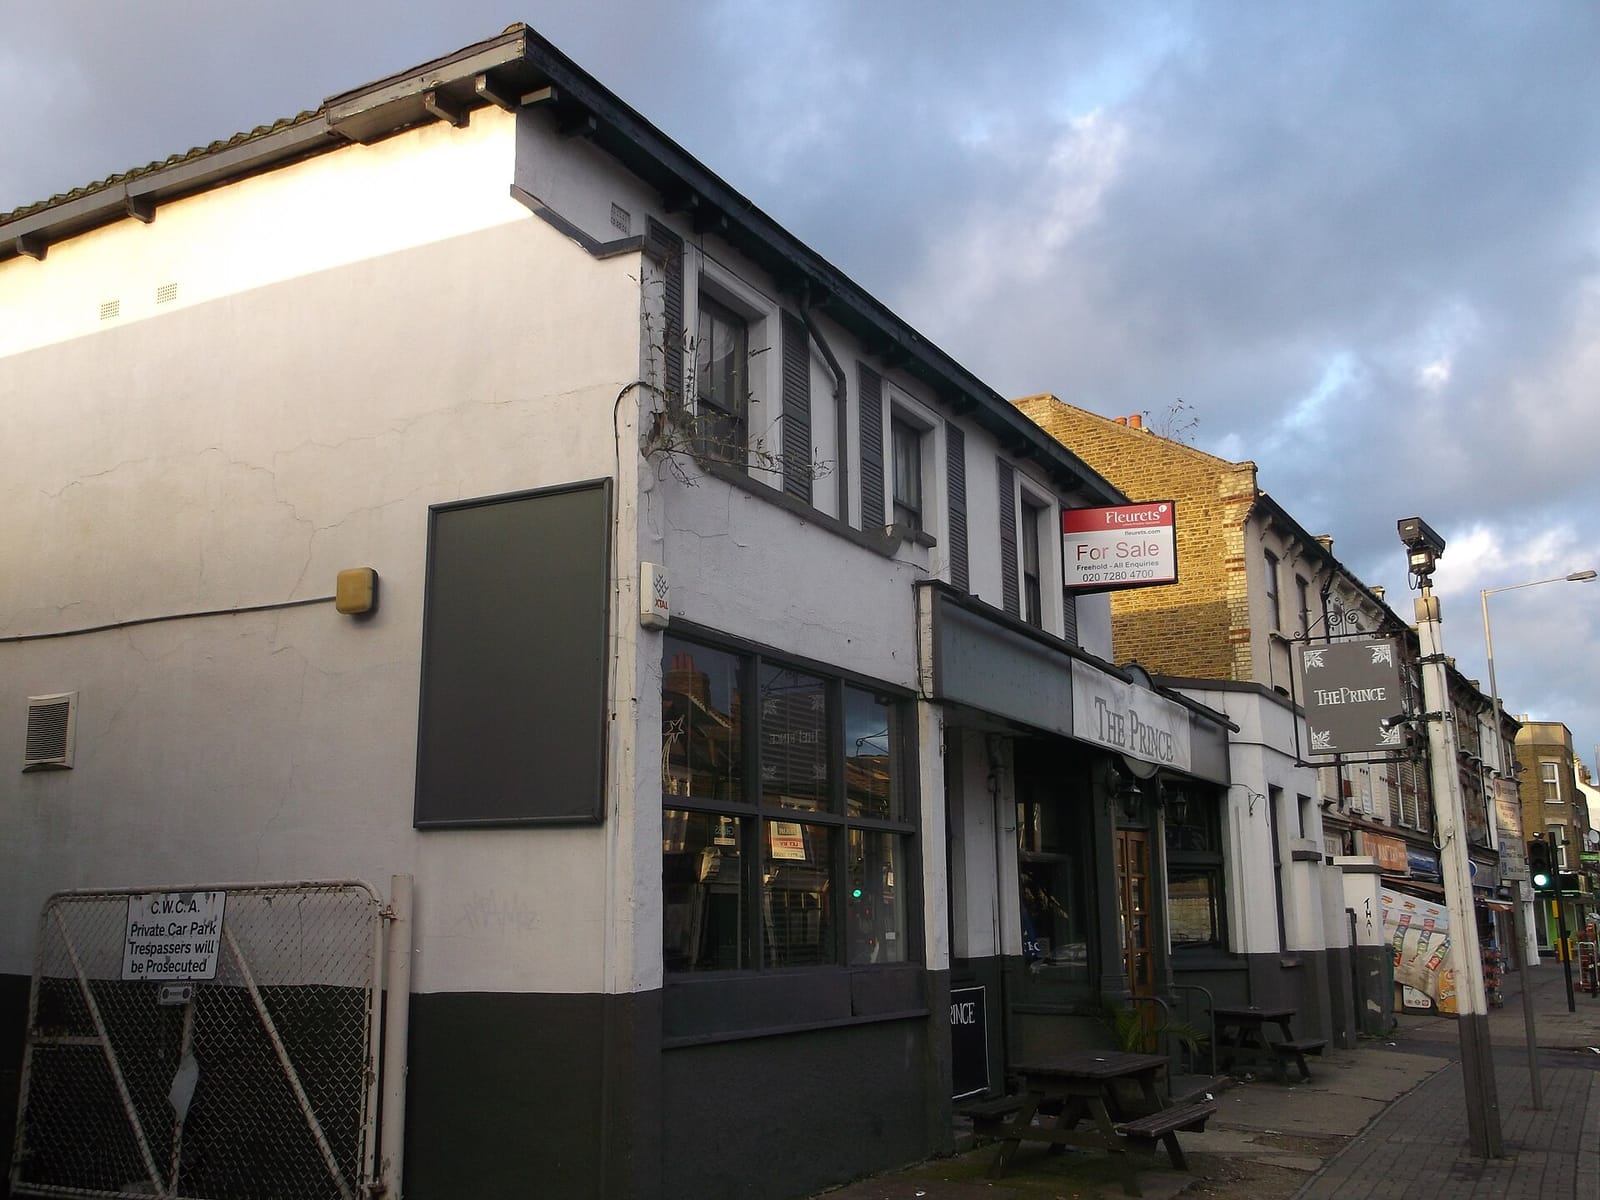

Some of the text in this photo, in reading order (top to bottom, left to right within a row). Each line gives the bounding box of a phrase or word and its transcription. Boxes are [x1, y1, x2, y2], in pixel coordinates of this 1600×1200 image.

[1106, 511, 1160, 523] Fleurets
[1076, 540, 1159, 561] For Sale
[1076, 563, 1108, 571] Freehold
[1125, 560, 1159, 569] Enquiries
[1082, 569, 1154, 582] 020 7280 4700
[1095, 696, 1173, 762] THE PRINCE
[131, 921, 216, 936] Private Car Park
[129, 941, 214, 957] Trespassers will
[131, 959, 207, 973] be Prosecuted
